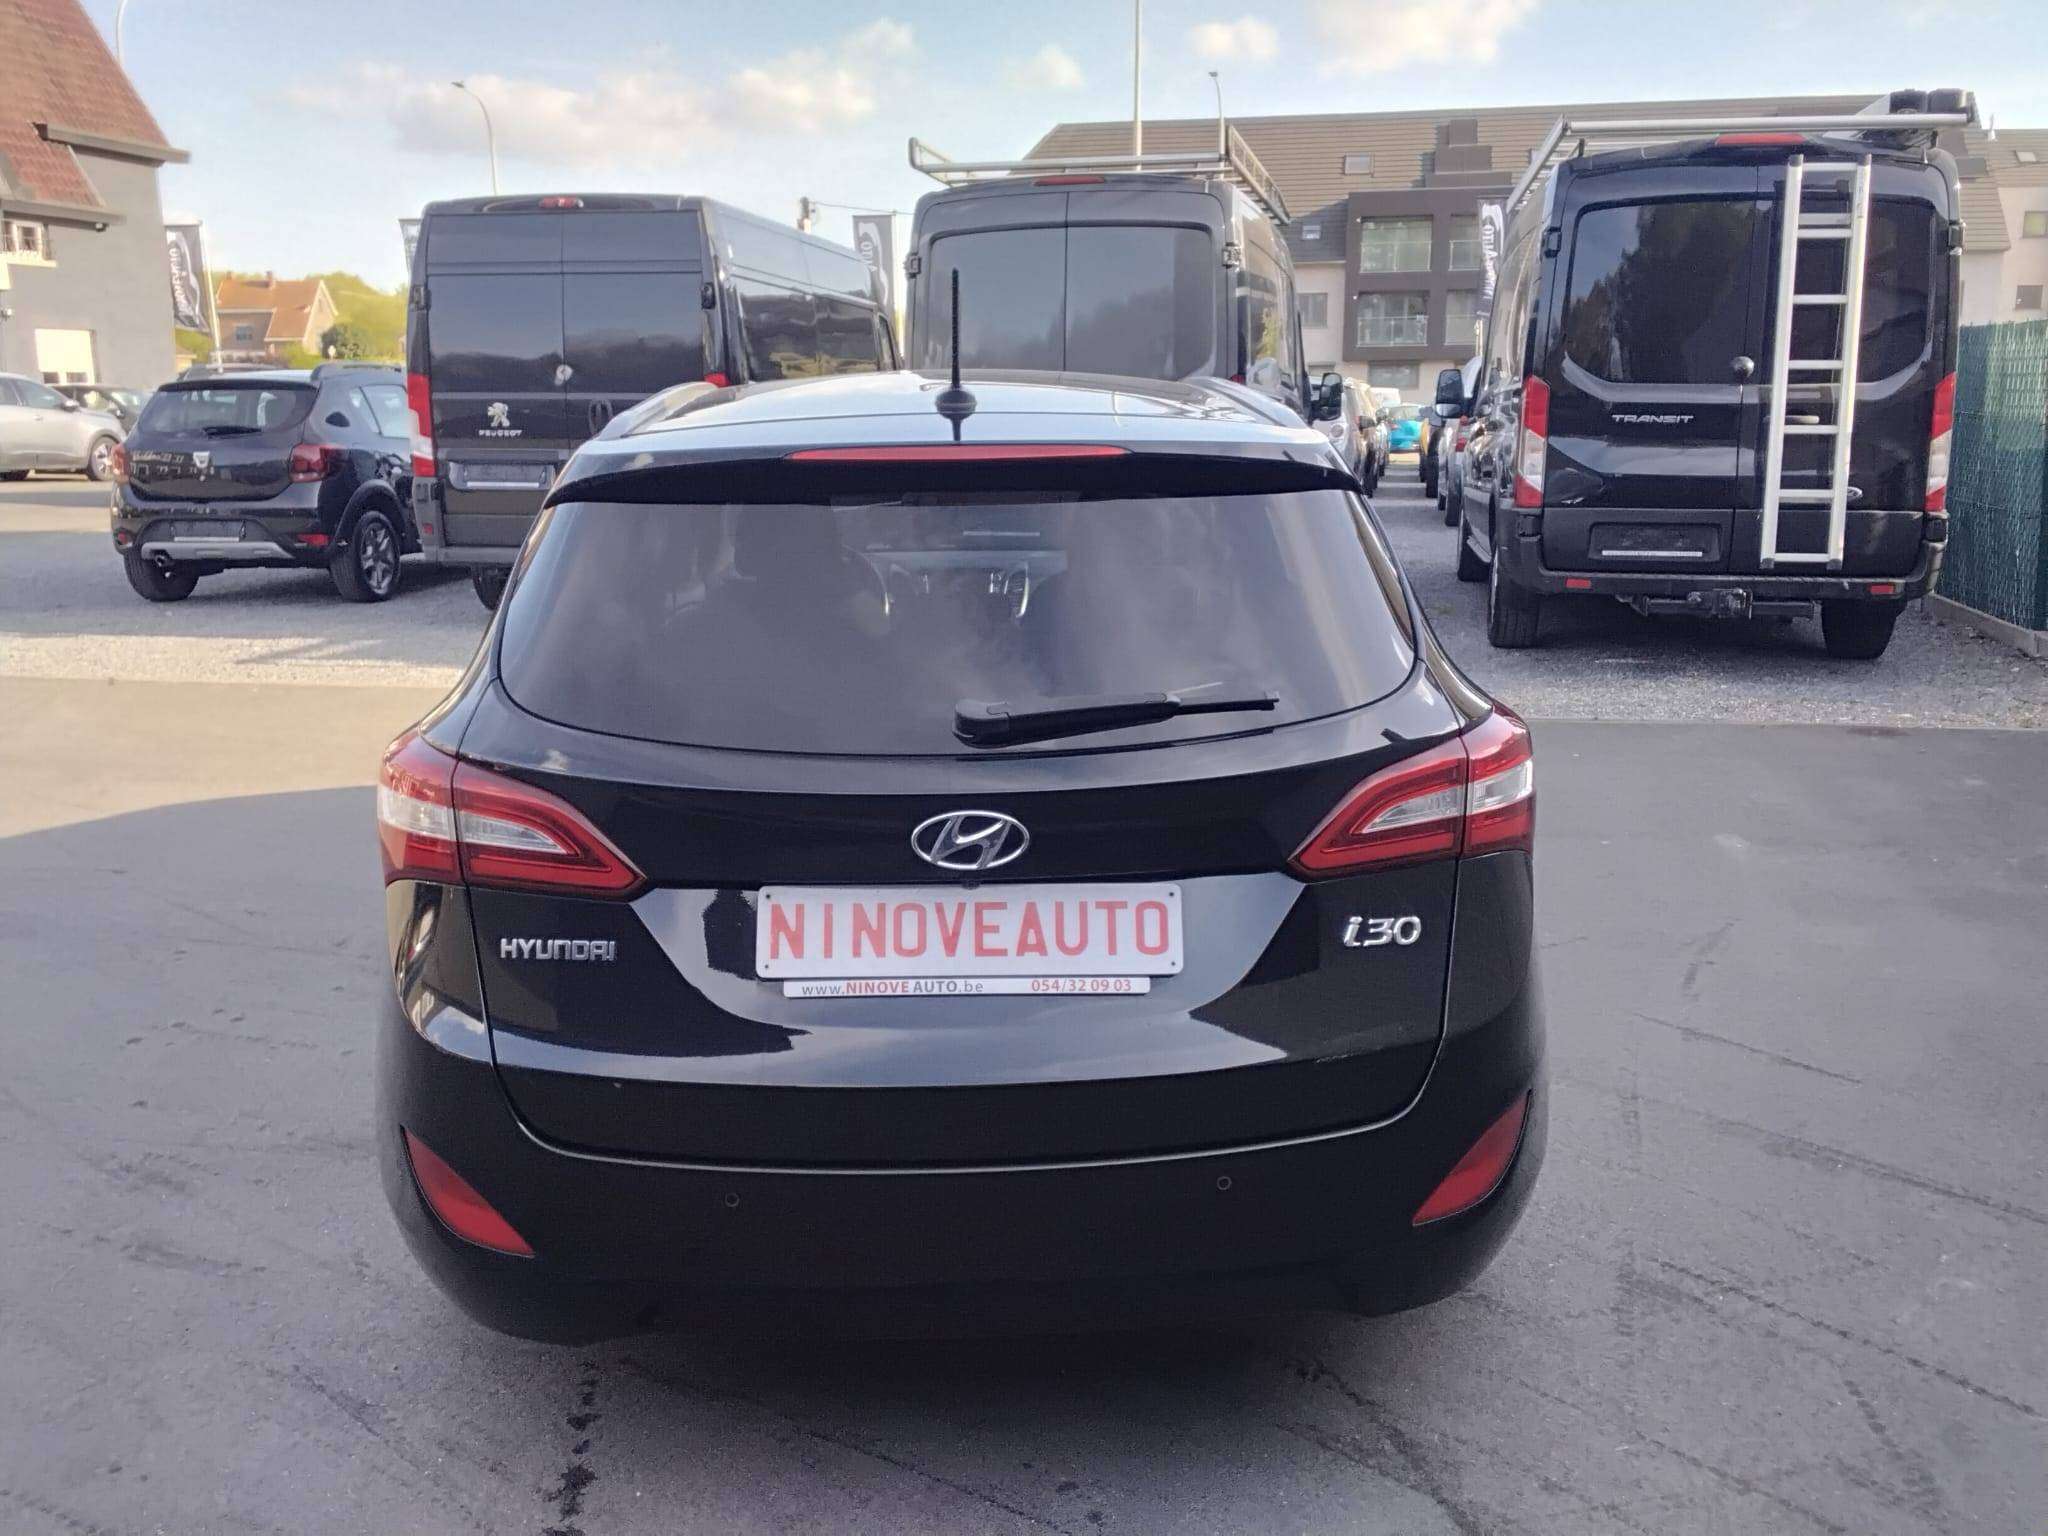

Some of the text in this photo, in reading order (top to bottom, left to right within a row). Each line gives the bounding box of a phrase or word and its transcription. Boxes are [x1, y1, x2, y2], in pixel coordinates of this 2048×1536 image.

[1611, 414, 1694, 424] TRANSIT
[769, 900, 1170, 960] NINOVEAUTO
[1343, 916, 1422, 947] i30
[500, 938, 616, 961] HYUNDAI
